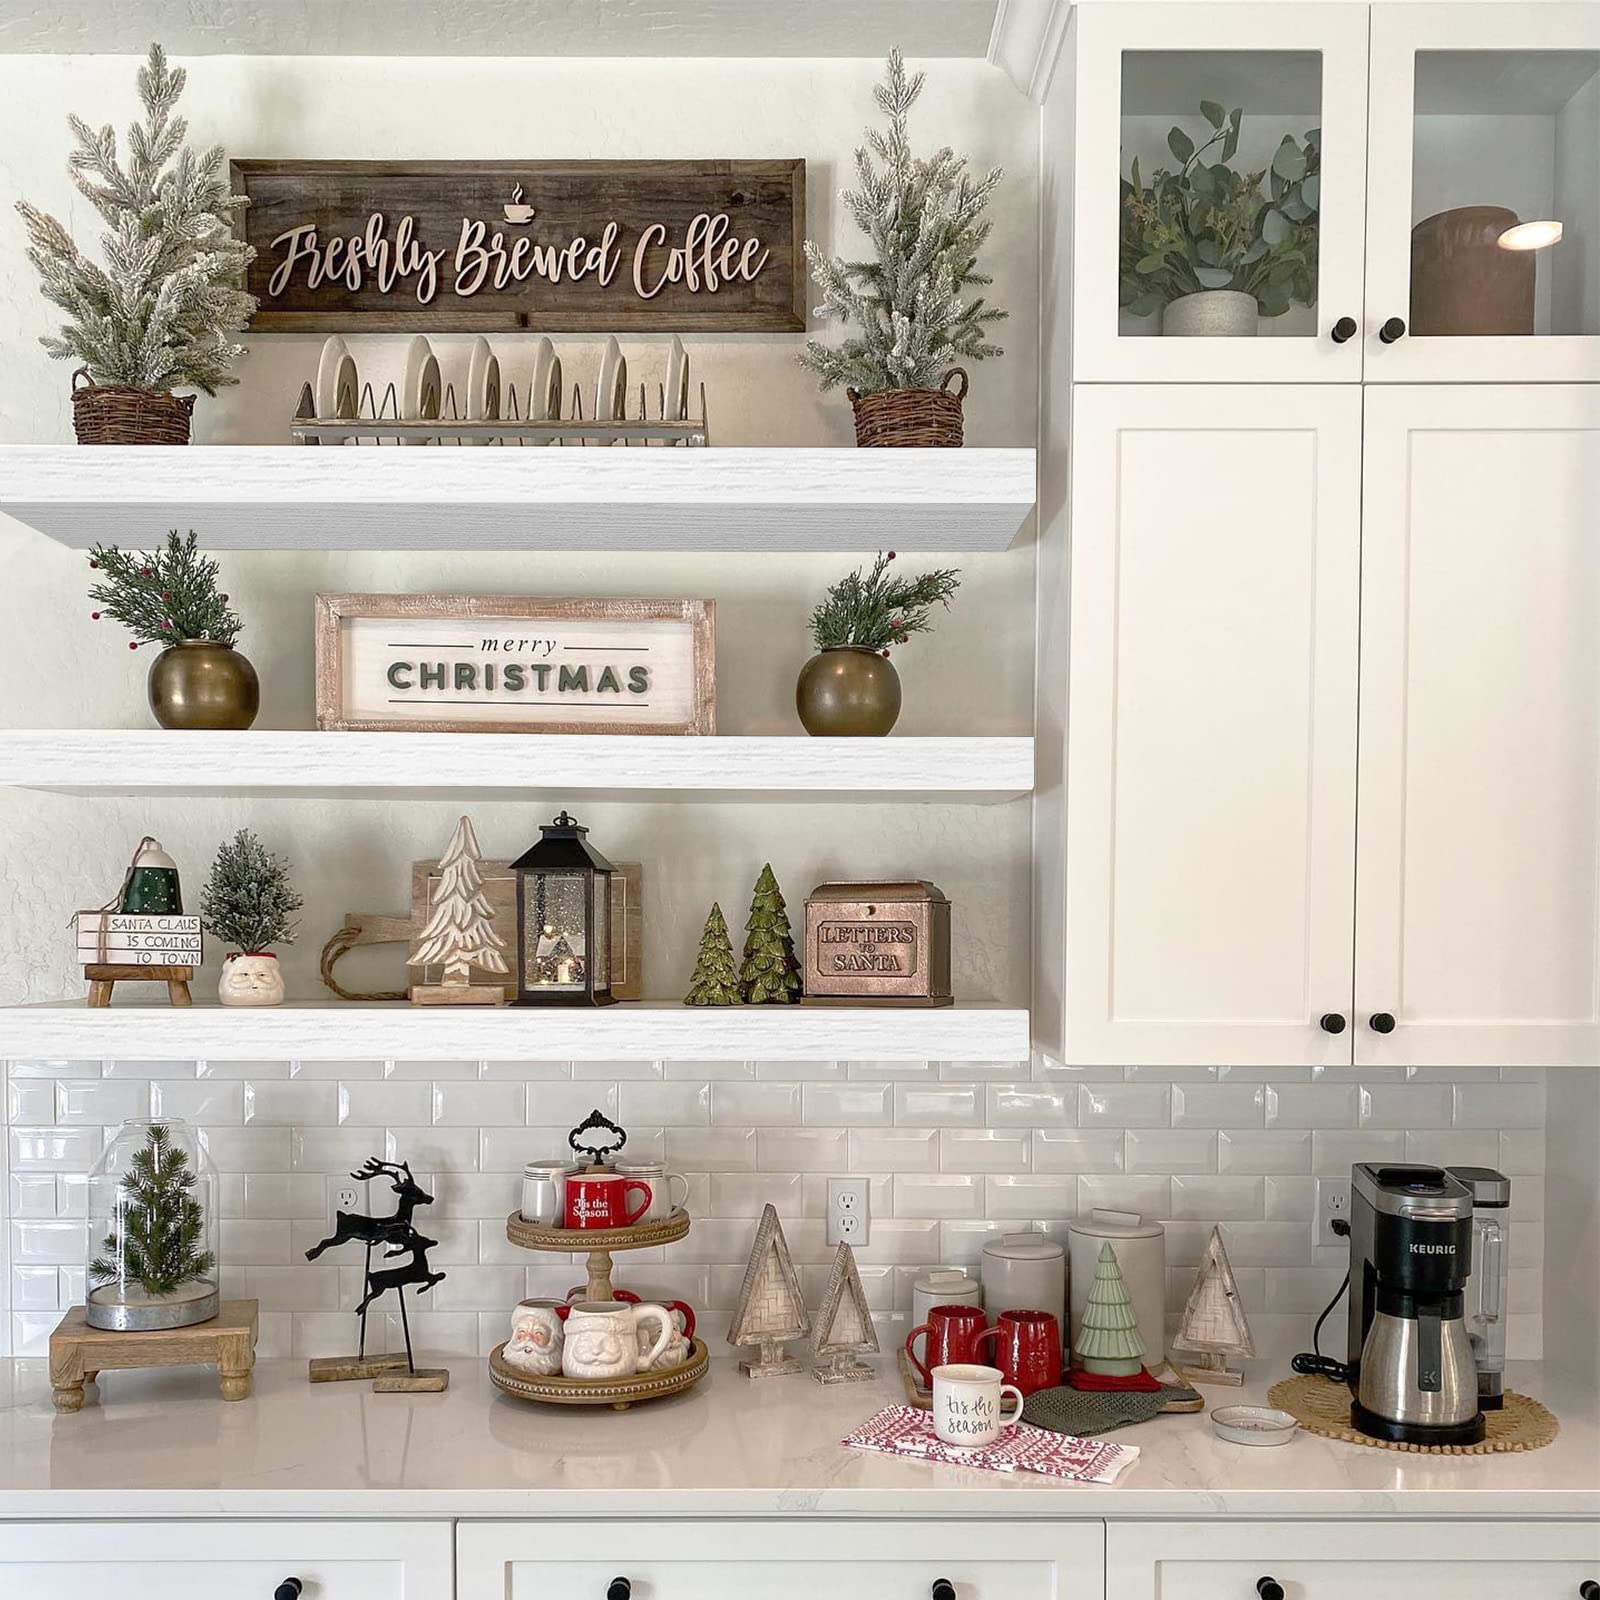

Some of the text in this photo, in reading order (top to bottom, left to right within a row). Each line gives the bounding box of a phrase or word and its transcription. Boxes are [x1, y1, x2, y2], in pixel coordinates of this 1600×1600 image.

[269, 213, 770, 305] Freshly Brewed Coffee
[481, 637, 557, 656] merry
[387, 661, 650, 693] CHRISTMAS
[111, 918, 198, 930] SANTA CLAUS
[127, 935, 199, 948] IS COMING
[821, 926, 914, 944] LETTERS
[134, 952, 199, 964] TO TOWN
[834, 953, 902, 972] SANTA
[572, 1206, 609, 1217] Season
[592, 1199, 608, 1208] the
[1409, 1243, 1456, 1255] KEURIG
[971, 1395, 993, 1416] the
[948, 1418, 993, 1434] season
